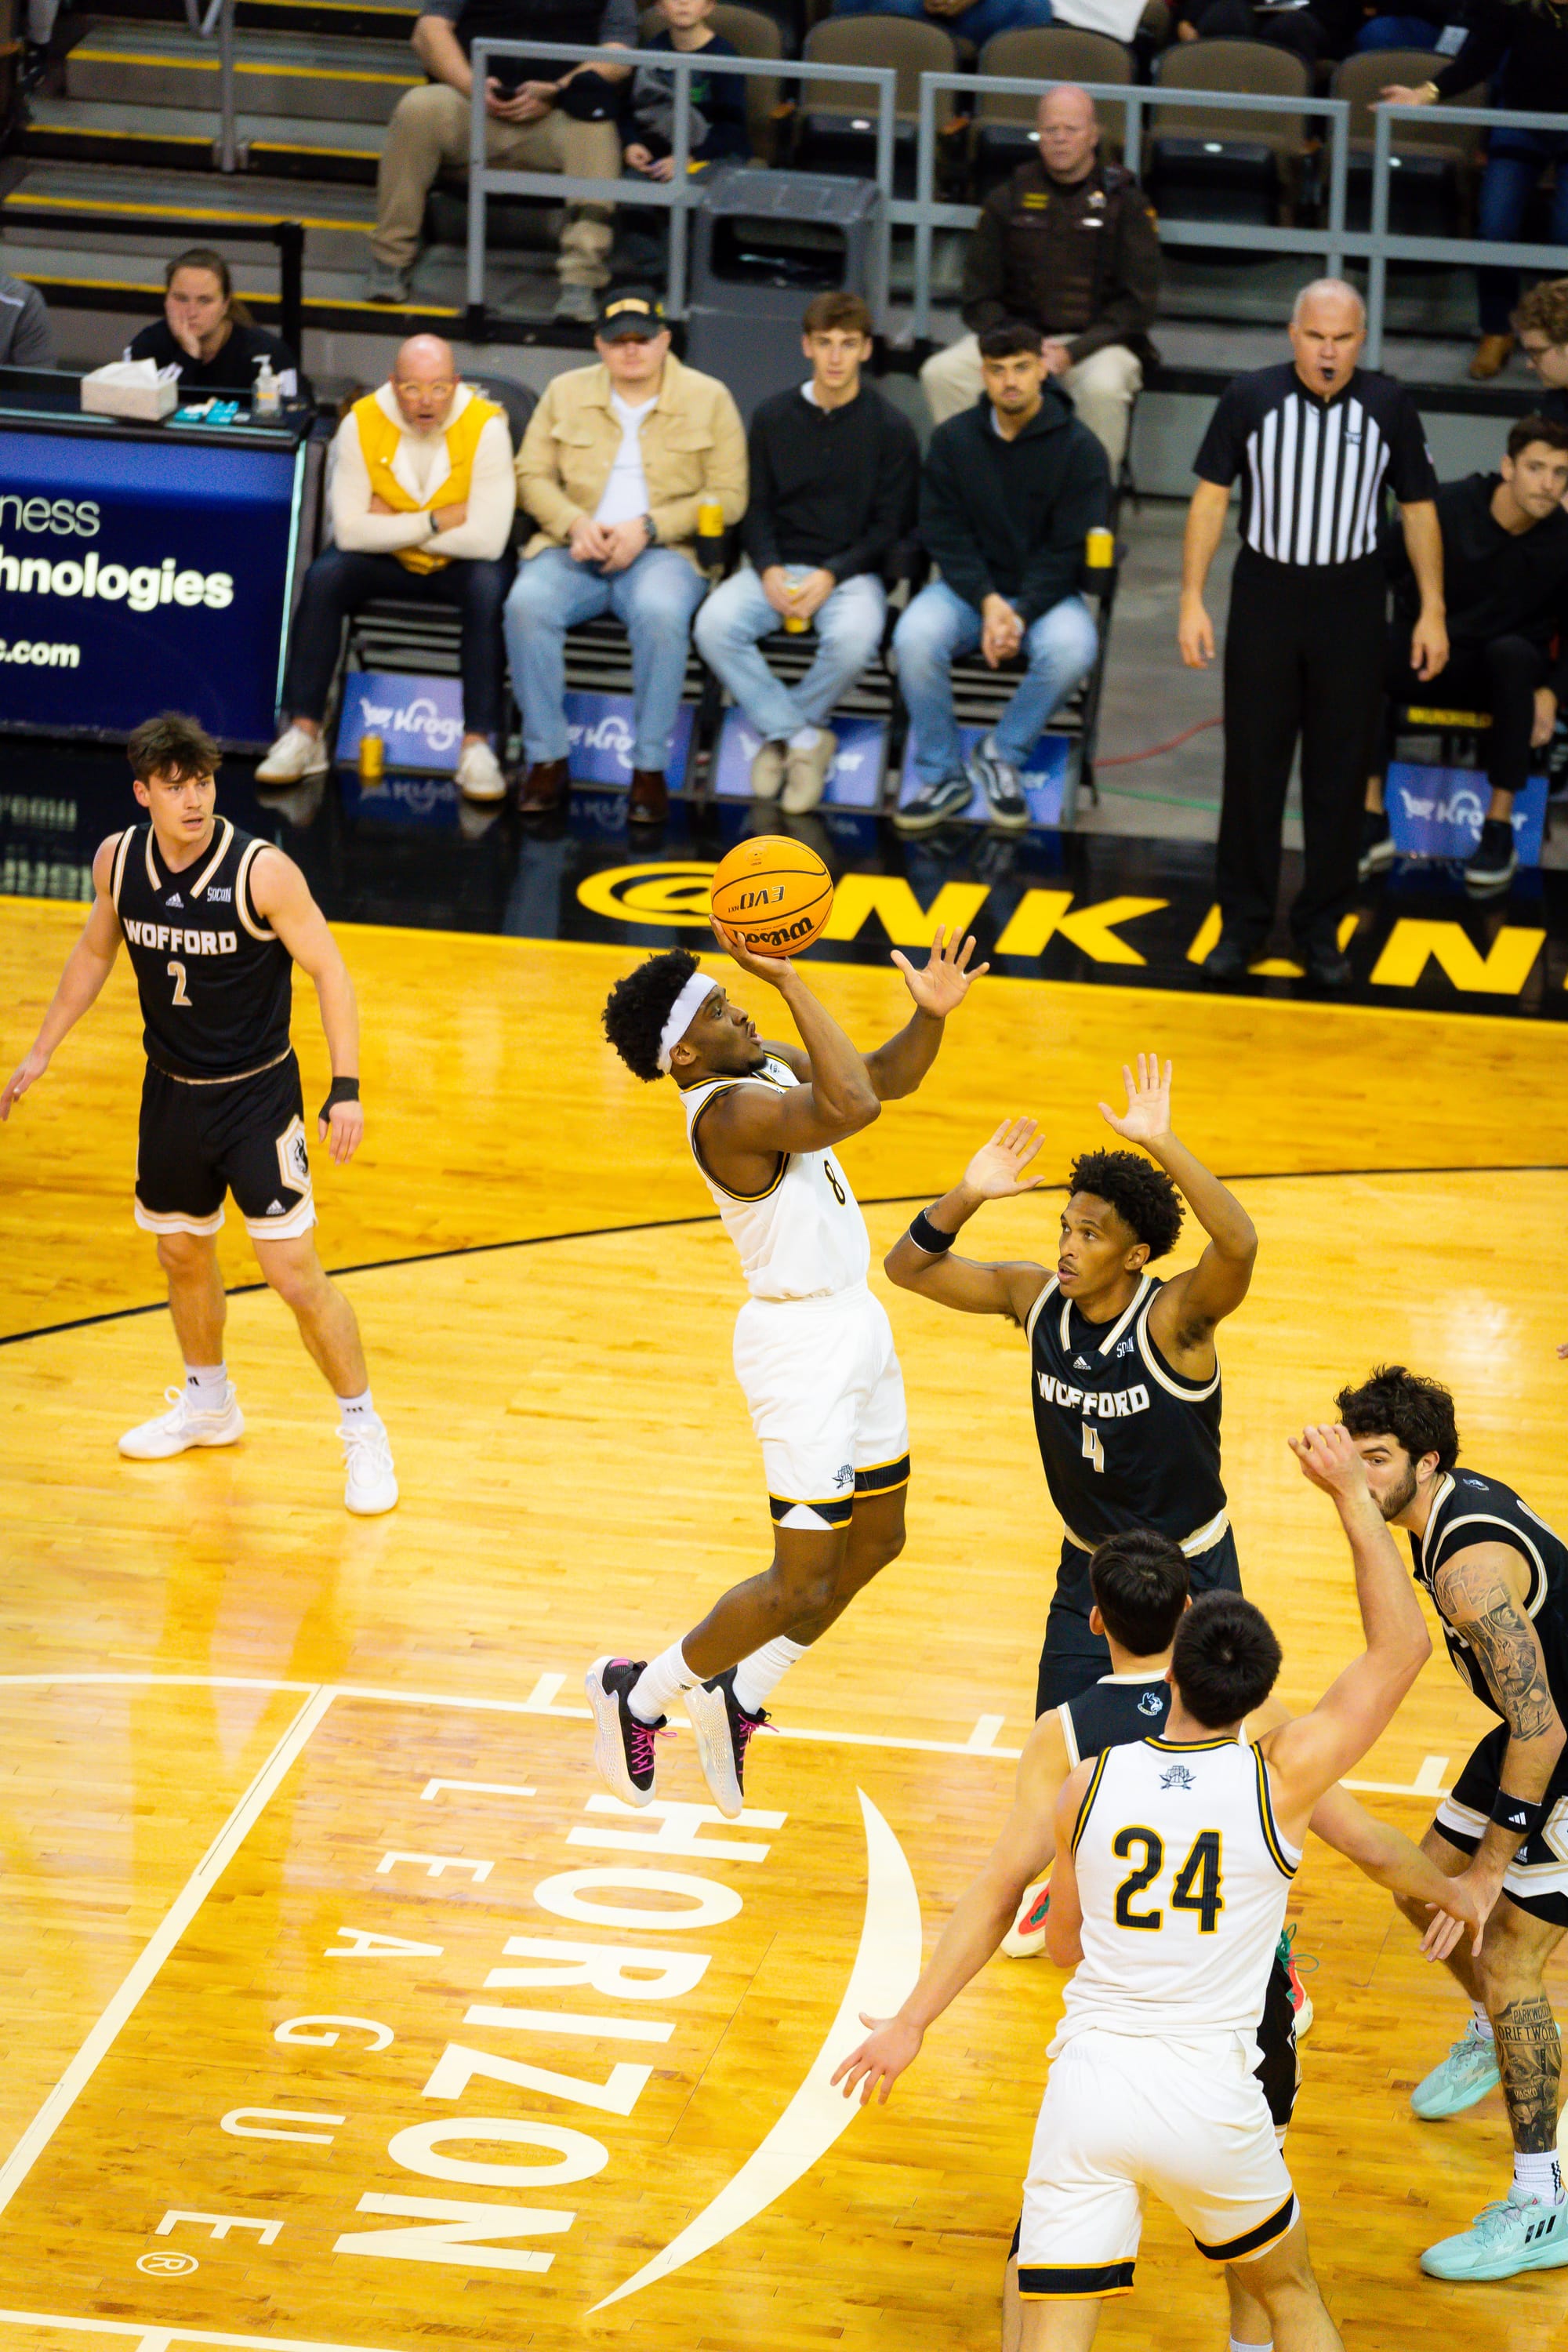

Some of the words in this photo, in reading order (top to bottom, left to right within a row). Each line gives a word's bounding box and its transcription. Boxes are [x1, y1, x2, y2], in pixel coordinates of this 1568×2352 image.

[740, 885, 785, 909] EVO
[122, 917, 238, 956] WOFFORD
[166, 960, 194, 1007] 2
[822, 1158, 846, 1206] 8
[1036, 1368, 1151, 1418] WOFFORD
[1081, 1421, 1105, 1474] 4
[1111, 1824, 1226, 1936] 24
[332, 1794, 789, 2274] HORIZON
